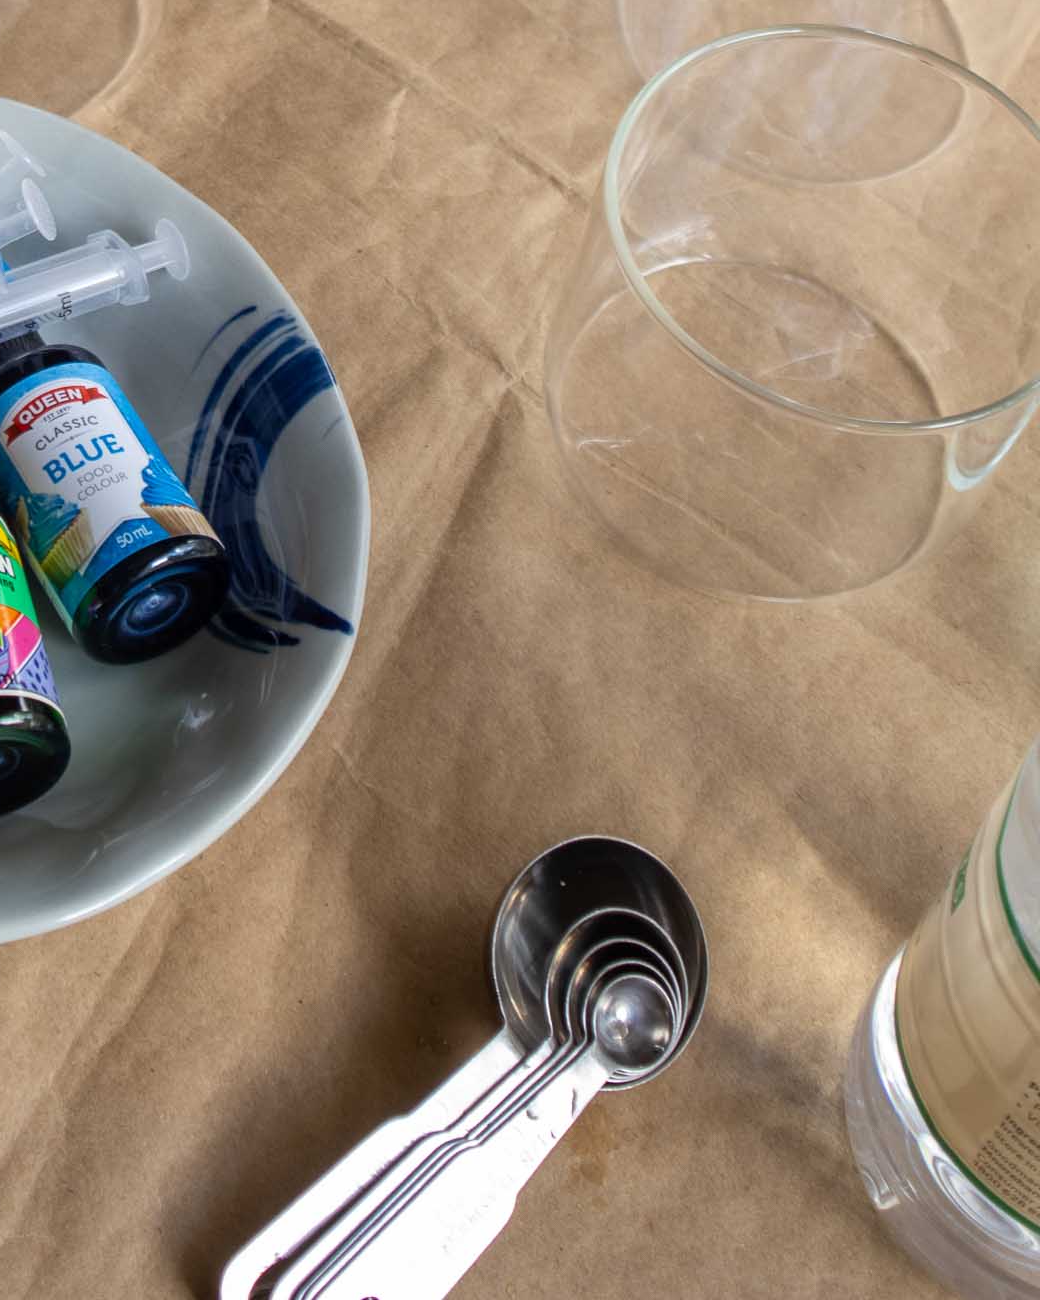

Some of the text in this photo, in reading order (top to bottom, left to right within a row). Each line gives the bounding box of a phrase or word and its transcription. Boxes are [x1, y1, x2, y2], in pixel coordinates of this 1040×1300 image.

[18, 388, 83, 426] QUEEN
[35, 415, 99, 451] CLASSIC
[42, 433, 125, 485] BLUE
[77, 464, 114, 487] FOOD
[76, 471, 129, 502] COLOUR
[116, 524, 153, 549] 50 mL
